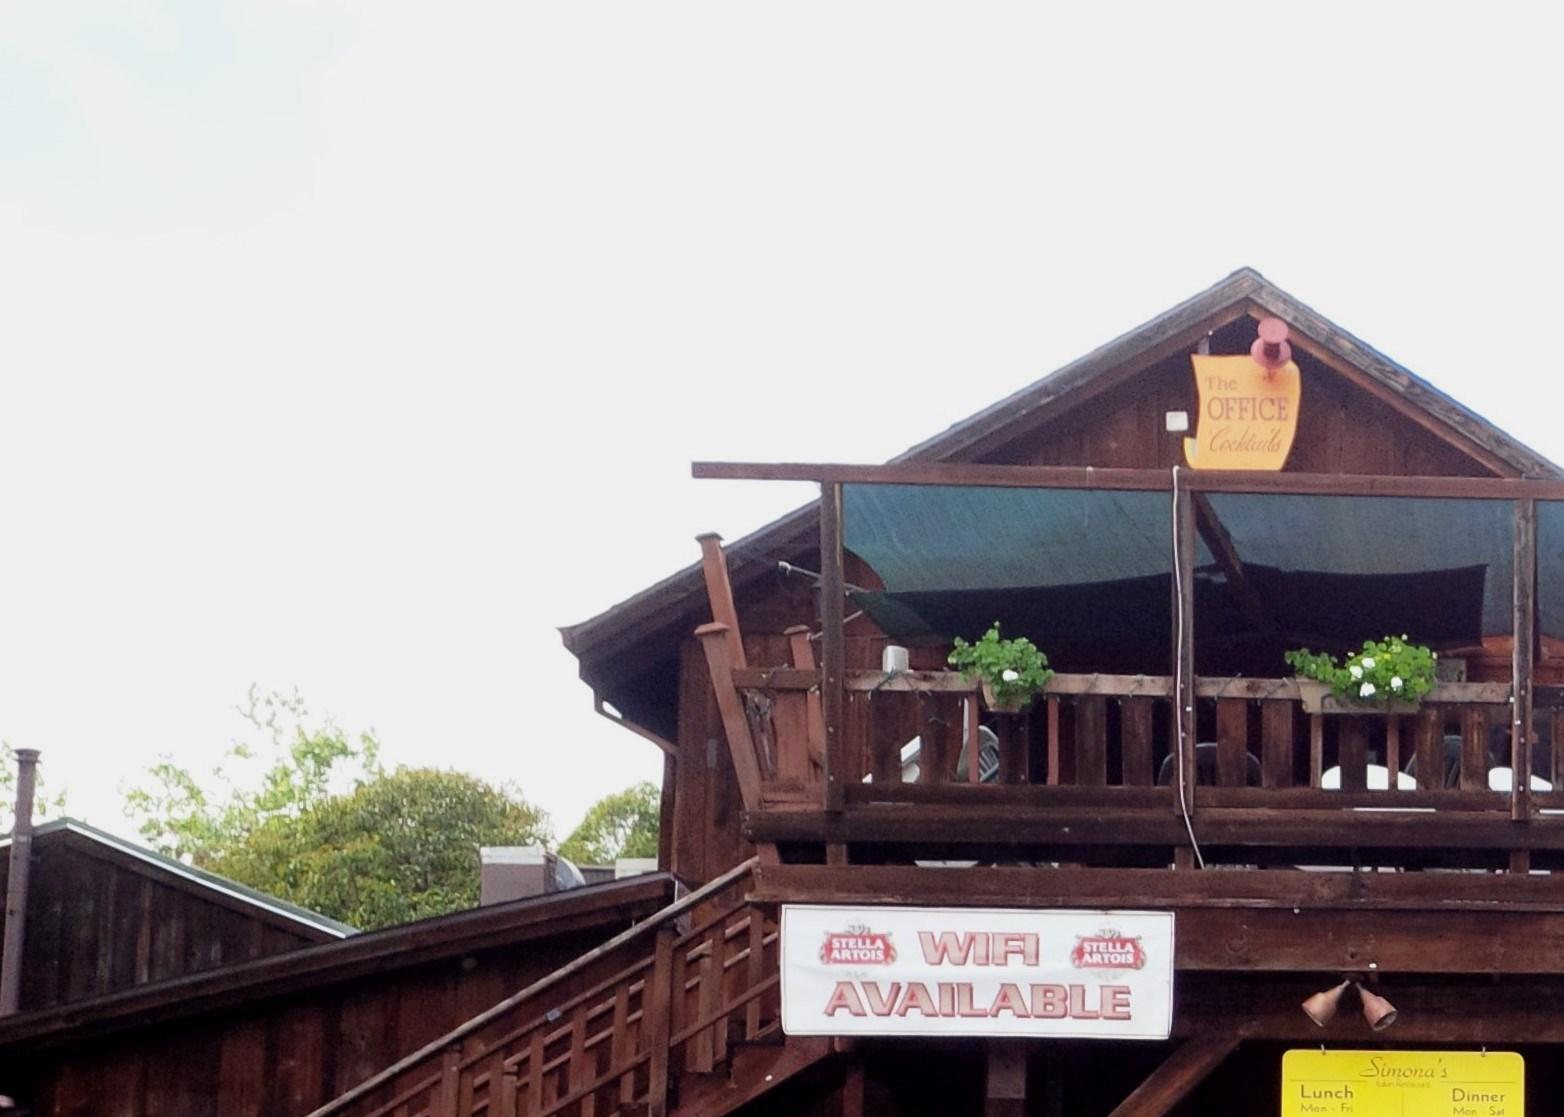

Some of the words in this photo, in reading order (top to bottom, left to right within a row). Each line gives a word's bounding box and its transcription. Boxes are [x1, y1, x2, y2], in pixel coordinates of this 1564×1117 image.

[1206, 376, 1238, 391] The
[1207, 396, 1289, 421] OFFICE
[1209, 426, 1282, 453] Cocktails
[831, 937, 885, 950] STELLA
[917, 930, 1041, 967] WIFI
[1082, 942, 1135, 954] STELLA
[830, 949, 885, 962] ARTOIS
[1081, 952, 1135, 965] ARTOIS
[822, 981, 1133, 1021] AVAILABLE
[1359, 1056, 1448, 1080] Simona's
[1300, 1084, 1354, 1099] Lunch
[1451, 1088, 1505, 1103] Dinner
[1300, 1103, 1328, 1113] Mon
[1340, 1103, 1354, 1113] Fri
[1452, 1106, 1477, 1116] Mon
[1489, 1106, 1505, 1116] Sat
